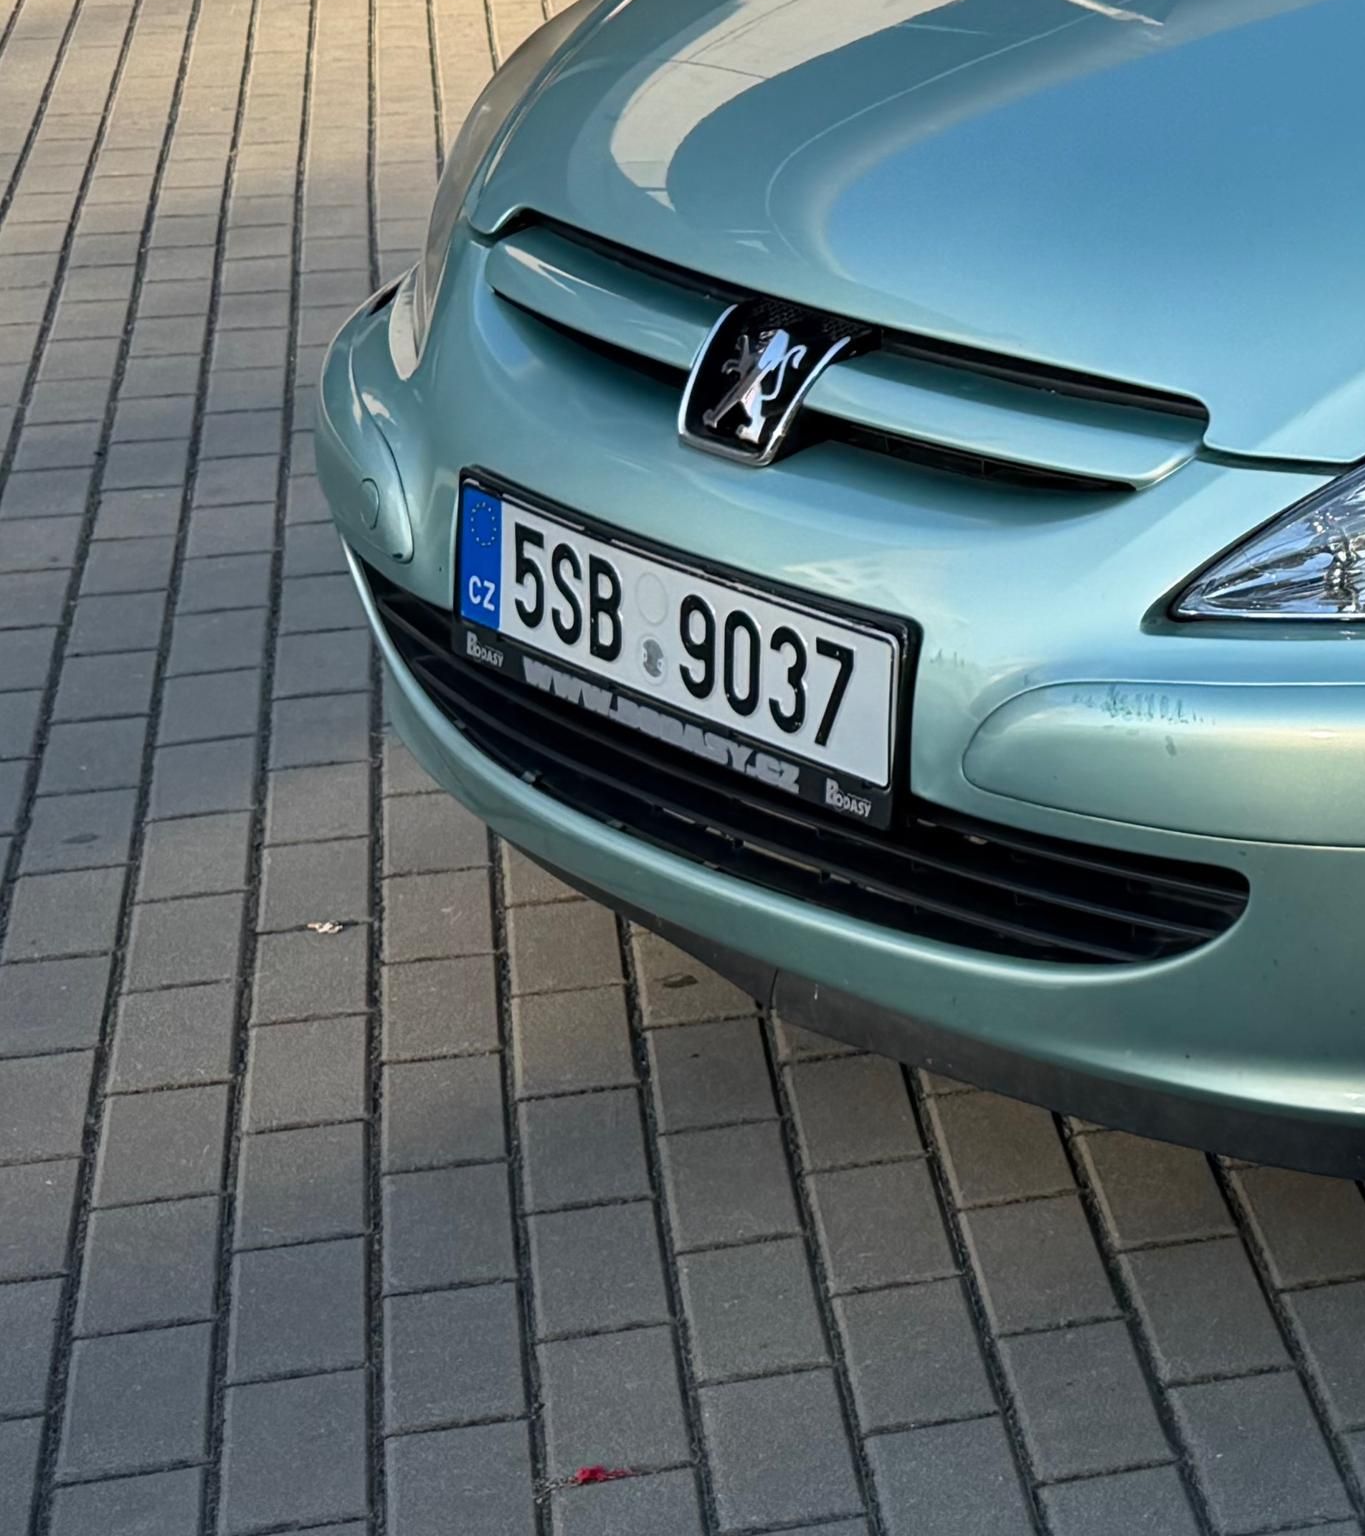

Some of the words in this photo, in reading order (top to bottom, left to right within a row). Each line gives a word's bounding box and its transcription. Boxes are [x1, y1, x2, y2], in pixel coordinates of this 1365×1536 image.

[468, 575, 496, 611] CZ
[515, 522, 623, 662] 5SB
[679, 594, 855, 747] 9037
